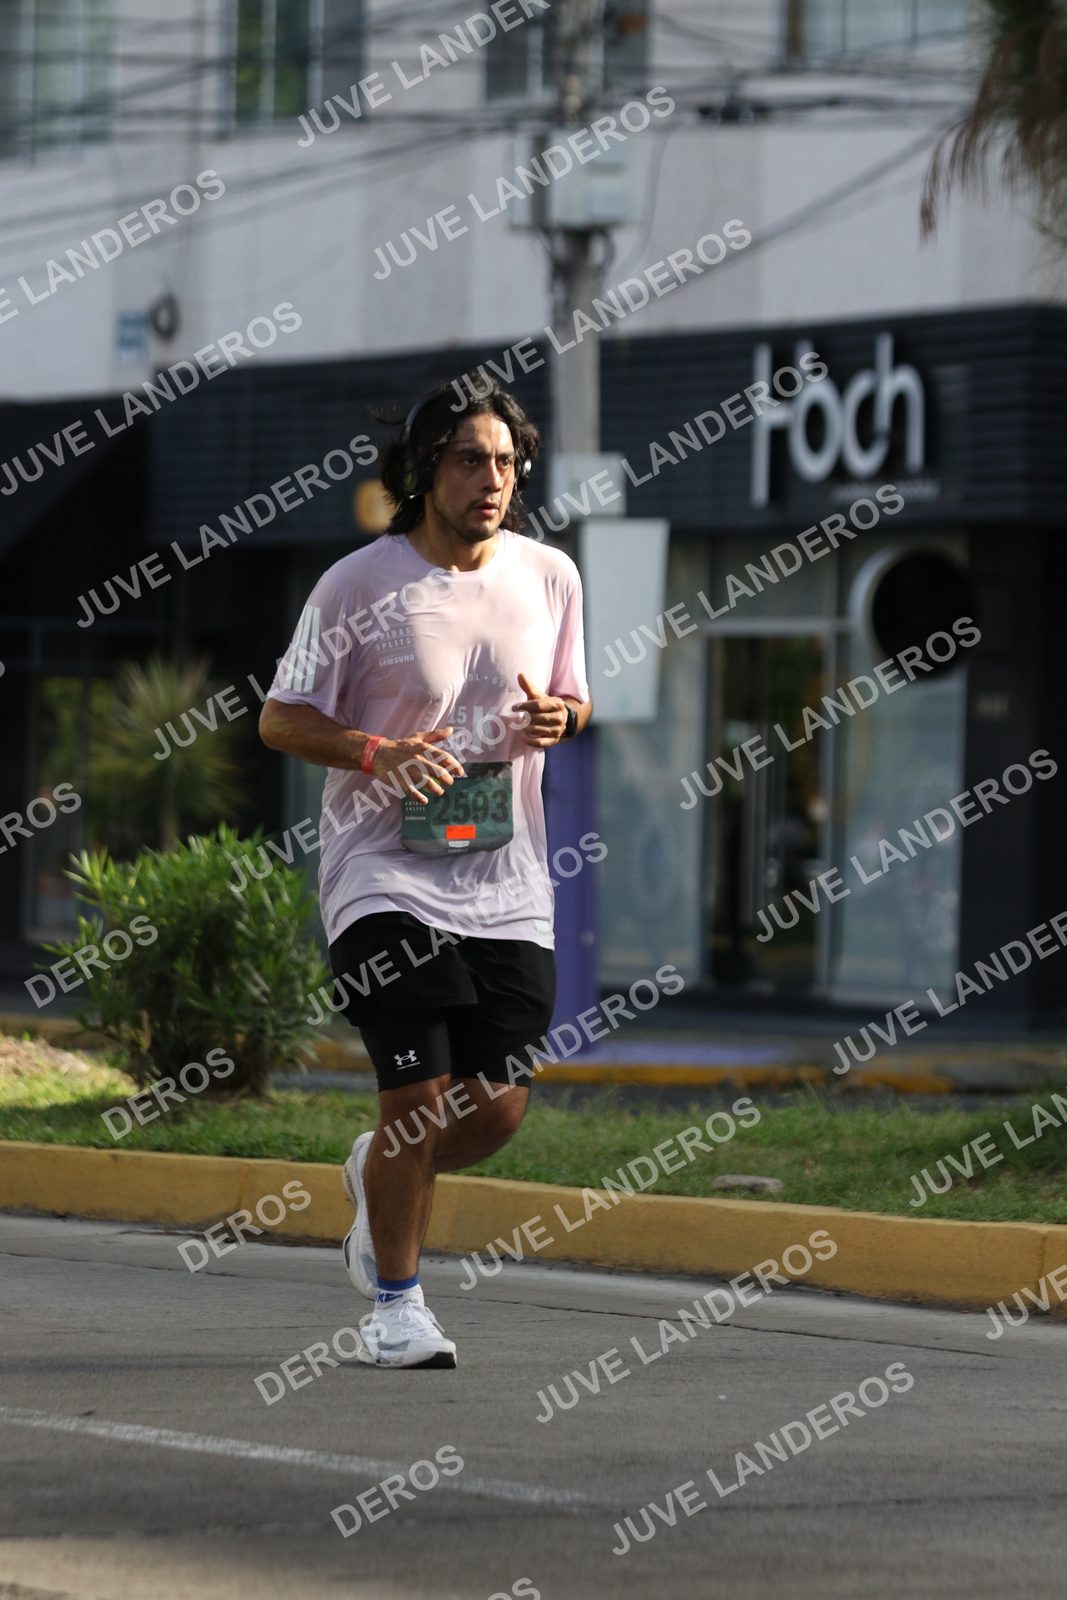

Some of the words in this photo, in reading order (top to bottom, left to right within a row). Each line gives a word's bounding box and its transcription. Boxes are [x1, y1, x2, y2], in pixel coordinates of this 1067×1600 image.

[374, 626, 411, 641] DIDAS
[375, 637, 411, 651] SPLITS
[379, 653, 415, 667] SAMSUNG
[432, 788, 509, 826] 2593
